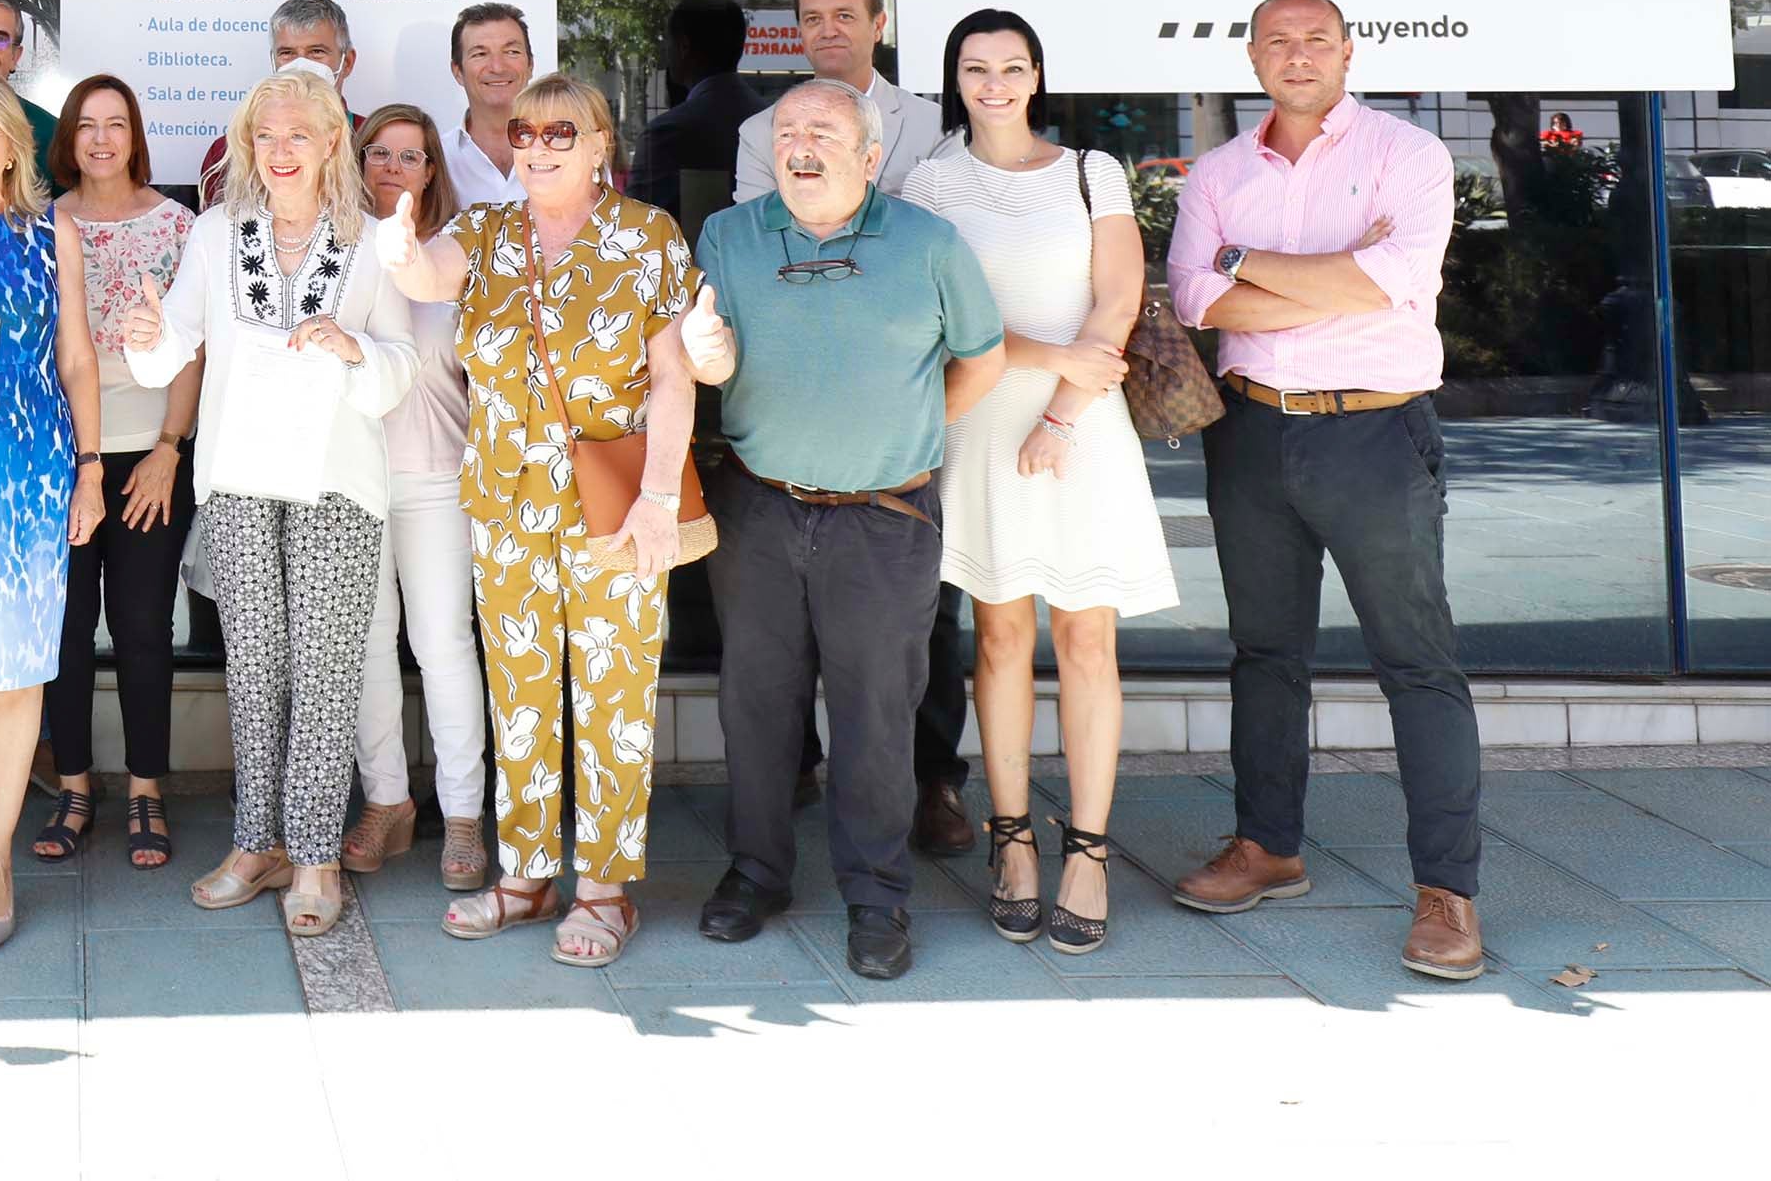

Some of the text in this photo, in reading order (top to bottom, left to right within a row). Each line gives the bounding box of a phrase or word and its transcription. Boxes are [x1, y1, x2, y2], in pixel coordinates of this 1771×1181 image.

[147, 16, 269, 33] Aula de docenc
[1345, 14, 1469, 45] ruyendo
[147, 51, 233, 67] Biblioteca.
[147, 86, 182, 101] Sala
[186, 86, 206, 101] de
[147, 120, 217, 136] Atención
